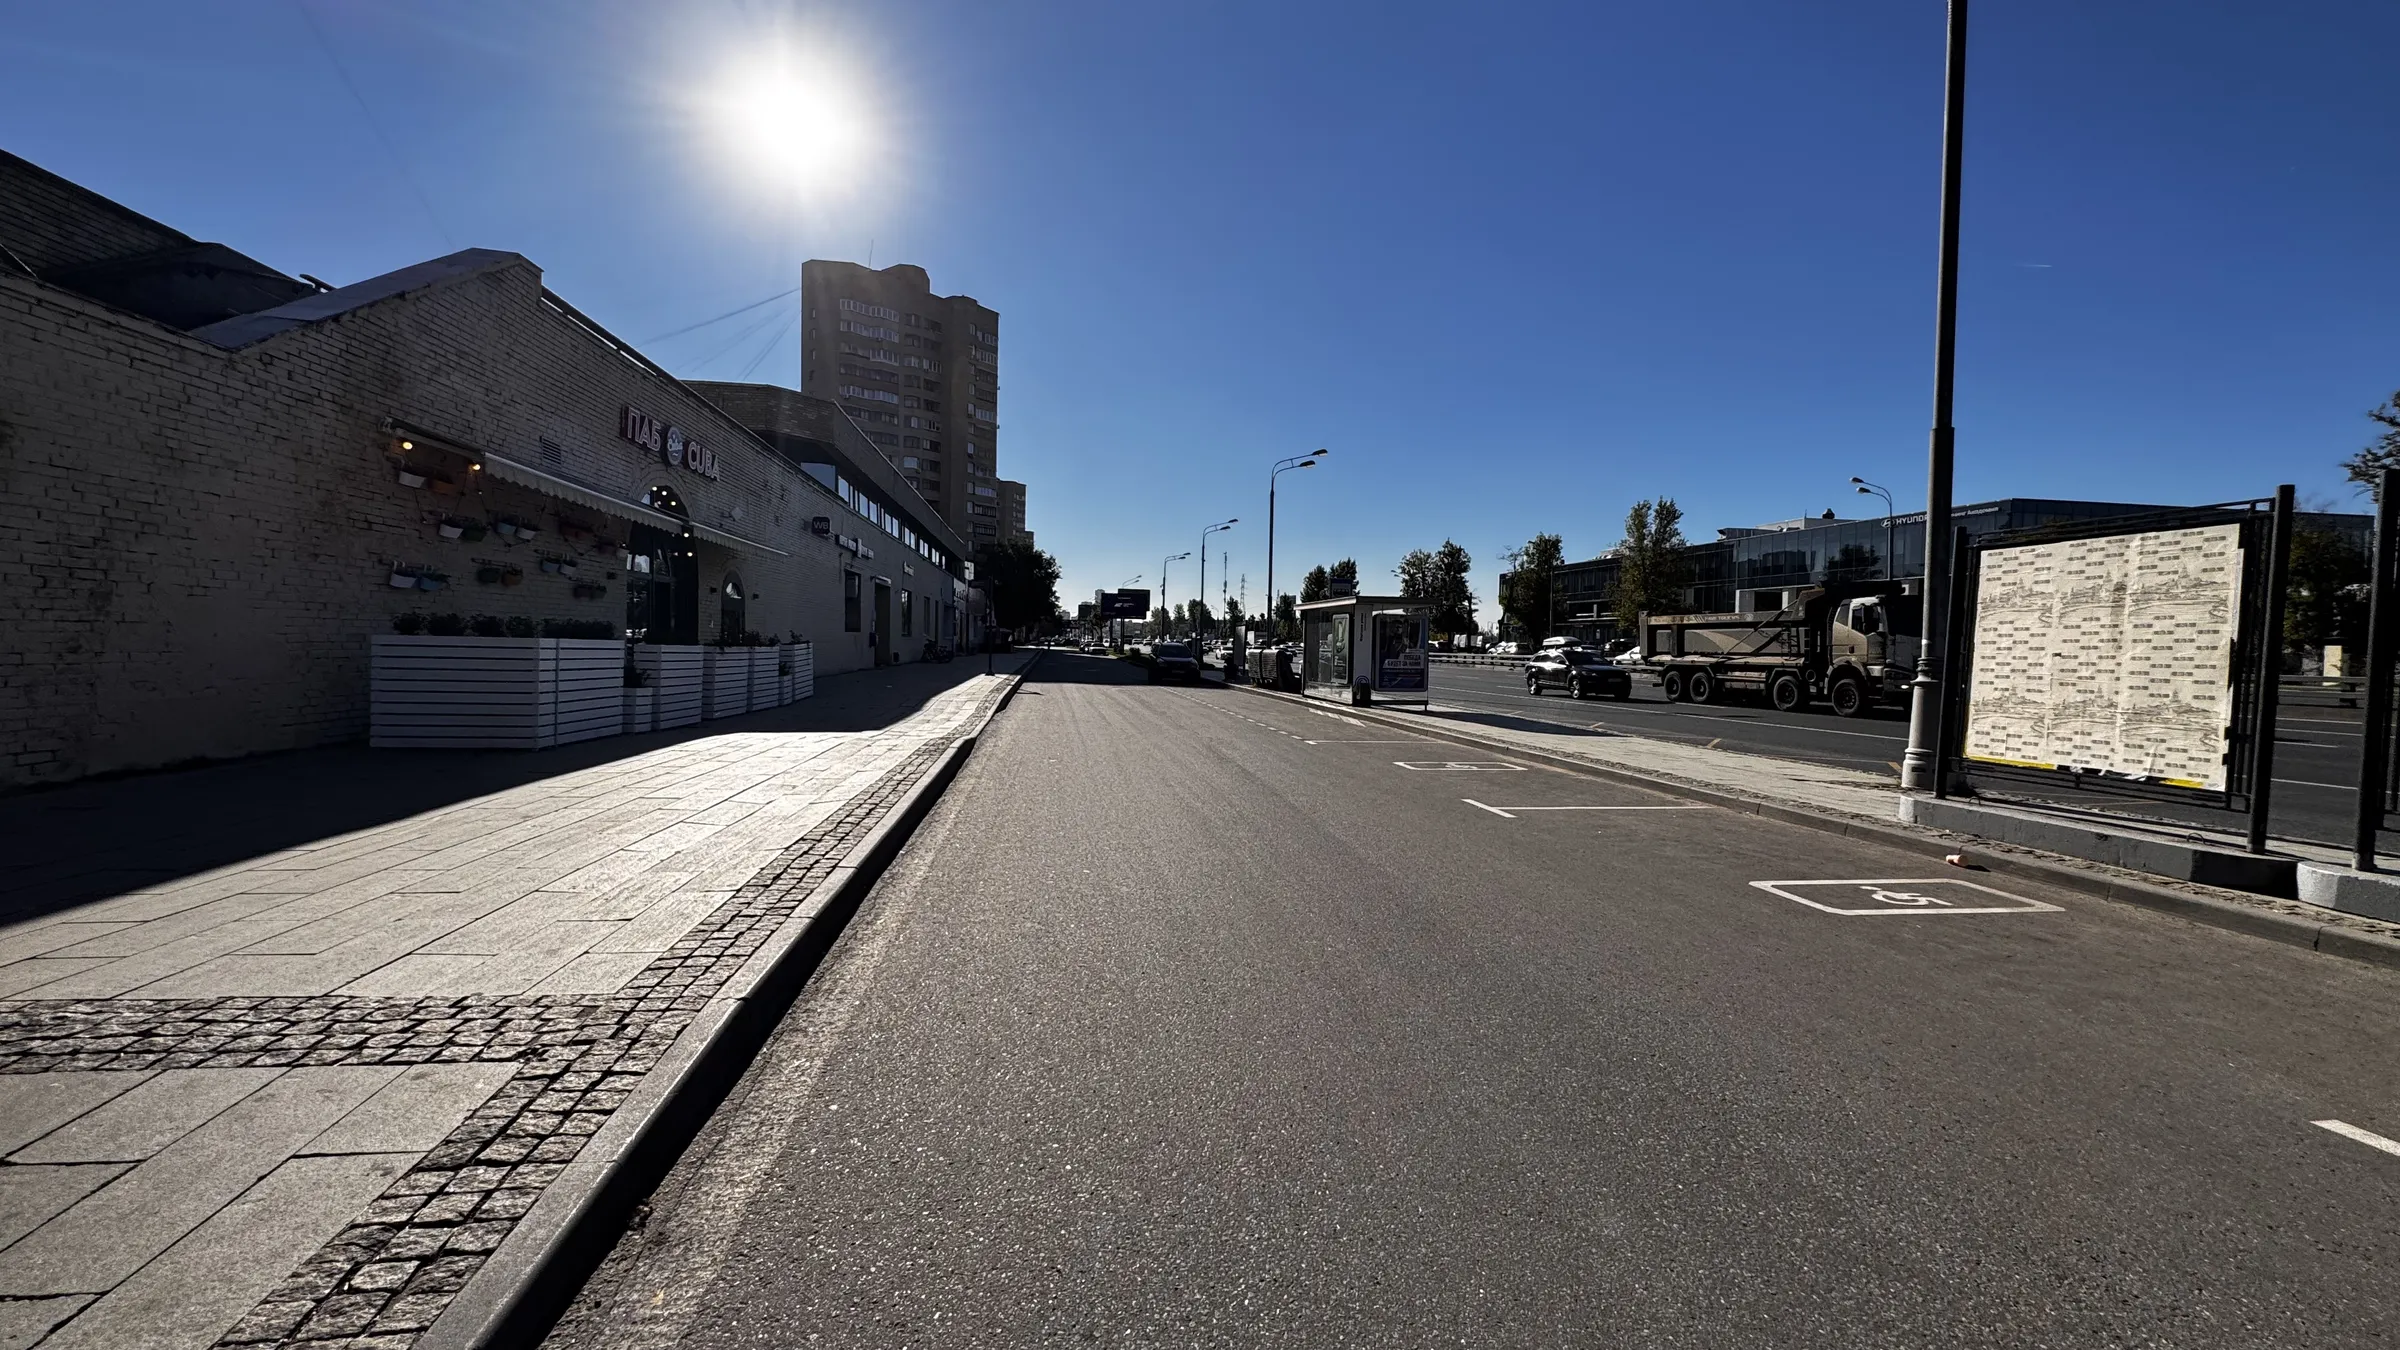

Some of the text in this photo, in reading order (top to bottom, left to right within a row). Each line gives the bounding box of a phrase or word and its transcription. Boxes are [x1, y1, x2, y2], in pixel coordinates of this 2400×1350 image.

[628, 405, 661, 451] ПАБ
[688, 441, 720, 481] CUBA
[813, 521, 829, 530] WB
[1896, 514, 1928, 525] HYUNDA
